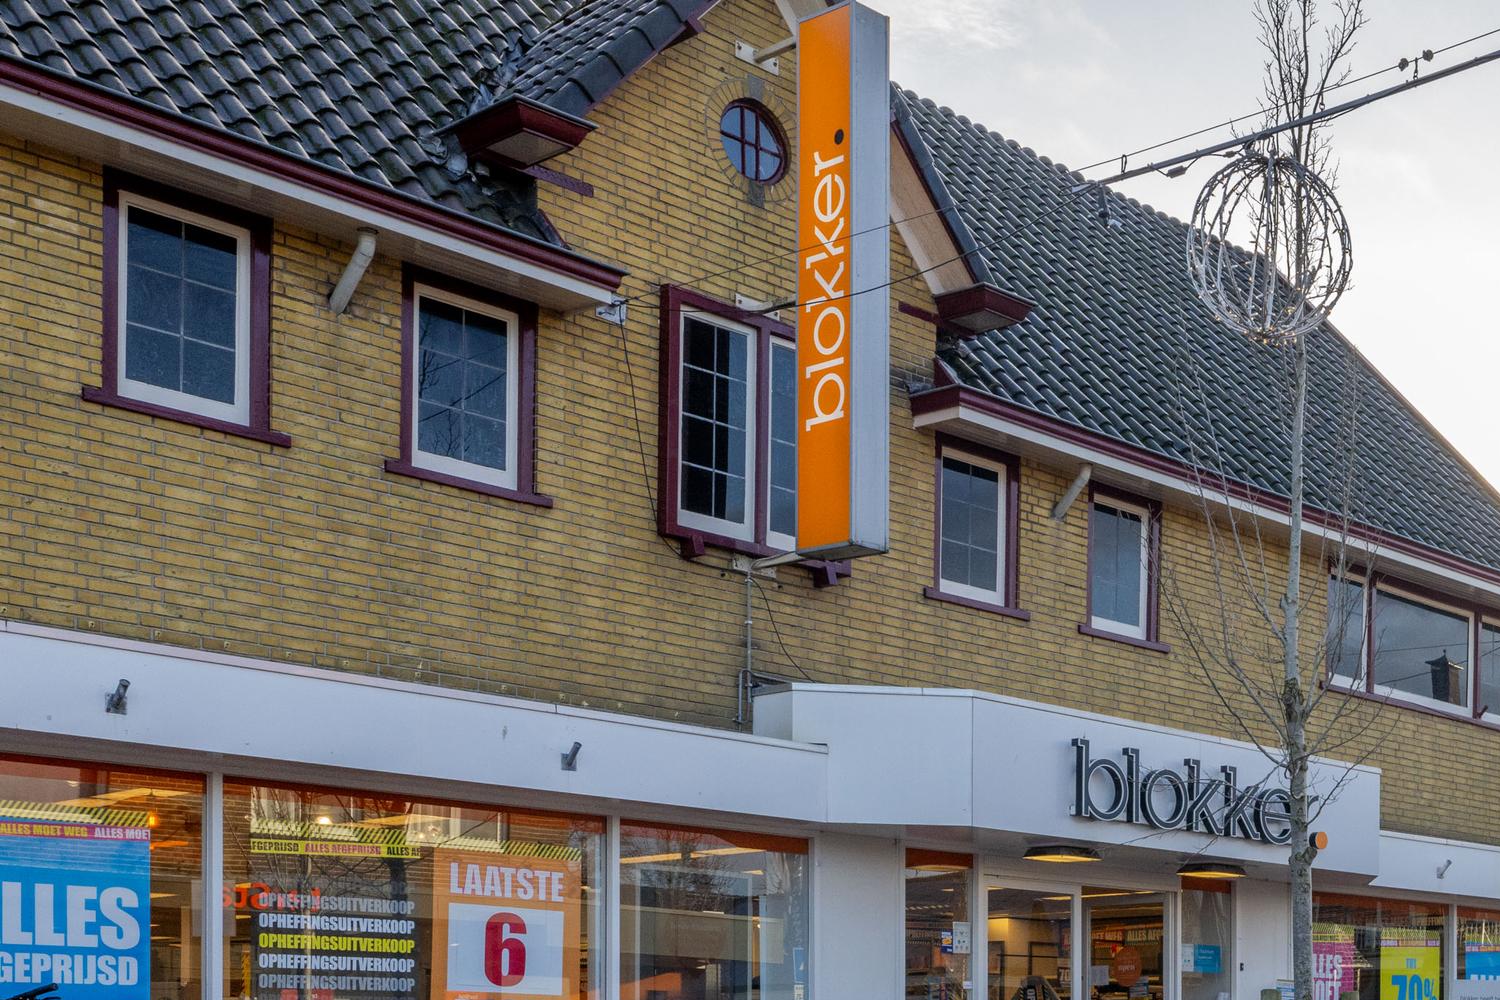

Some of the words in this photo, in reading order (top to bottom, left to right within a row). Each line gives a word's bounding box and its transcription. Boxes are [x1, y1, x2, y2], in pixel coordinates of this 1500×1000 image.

[0, 823, 31, 835] ALLES
[33, 825, 62, 836] MOET
[64, 826, 89, 837] WEG
[94, 827, 123, 839] ALLES
[450, 862, 564, 902] LAATSTE
[259, 912, 415, 934] OPHEFFINGSUITVERKOOP
[259, 933, 415, 953] OPHEFFINGSUITVERKOOP
[484, 912, 527, 987] 6
[259, 953, 415, 973] OPHEFFINGSUITVERKOOP
[259, 974, 415, 992] OPHEFFINGSUITVERKOOP
